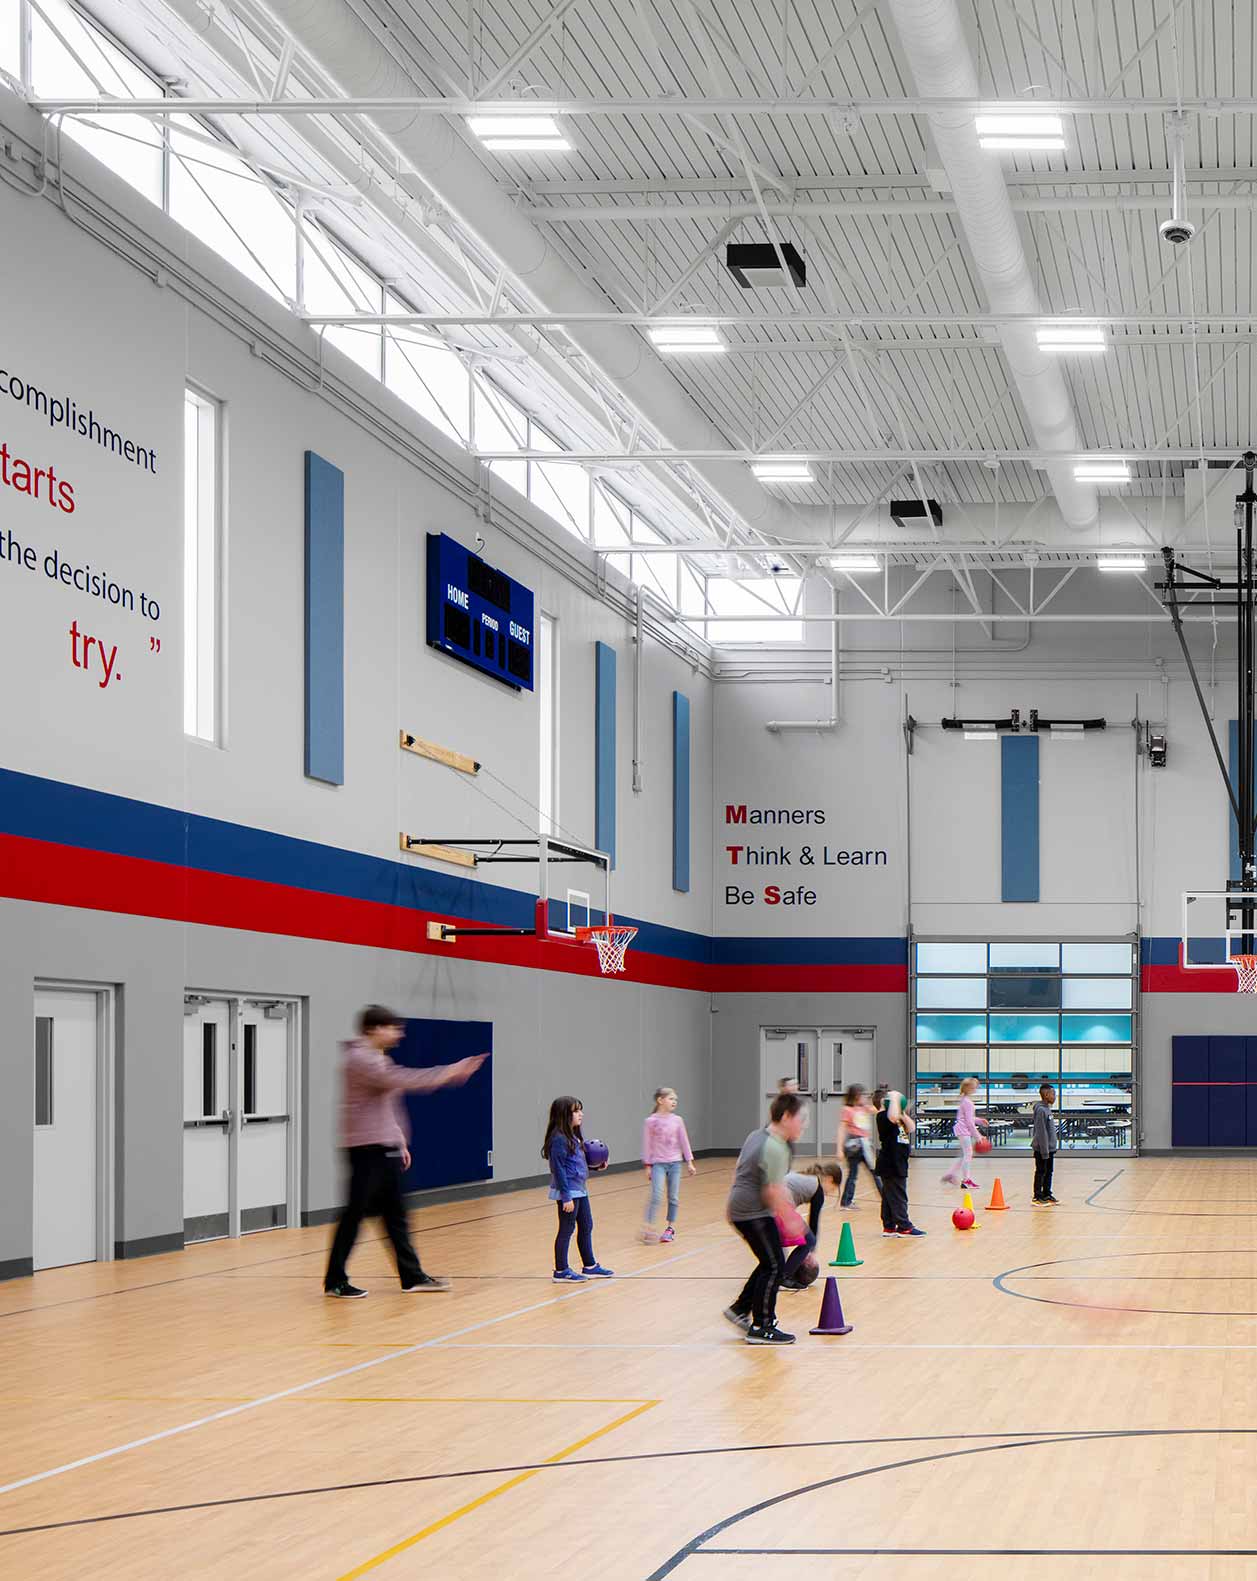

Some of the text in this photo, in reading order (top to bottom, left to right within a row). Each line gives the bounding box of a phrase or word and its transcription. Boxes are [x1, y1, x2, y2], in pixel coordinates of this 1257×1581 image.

[44, 550, 134, 610] decision
[140, 593, 160, 621] to
[447, 583, 469, 610] HOME
[481, 613, 499, 632] PERIOD
[509, 621, 530, 645] GUEST
[69, 620, 121, 688] try.
[725, 804, 826, 825] Manners
[725, 845, 887, 865] Think & Learn
[725, 885, 817, 905] Be Safe
